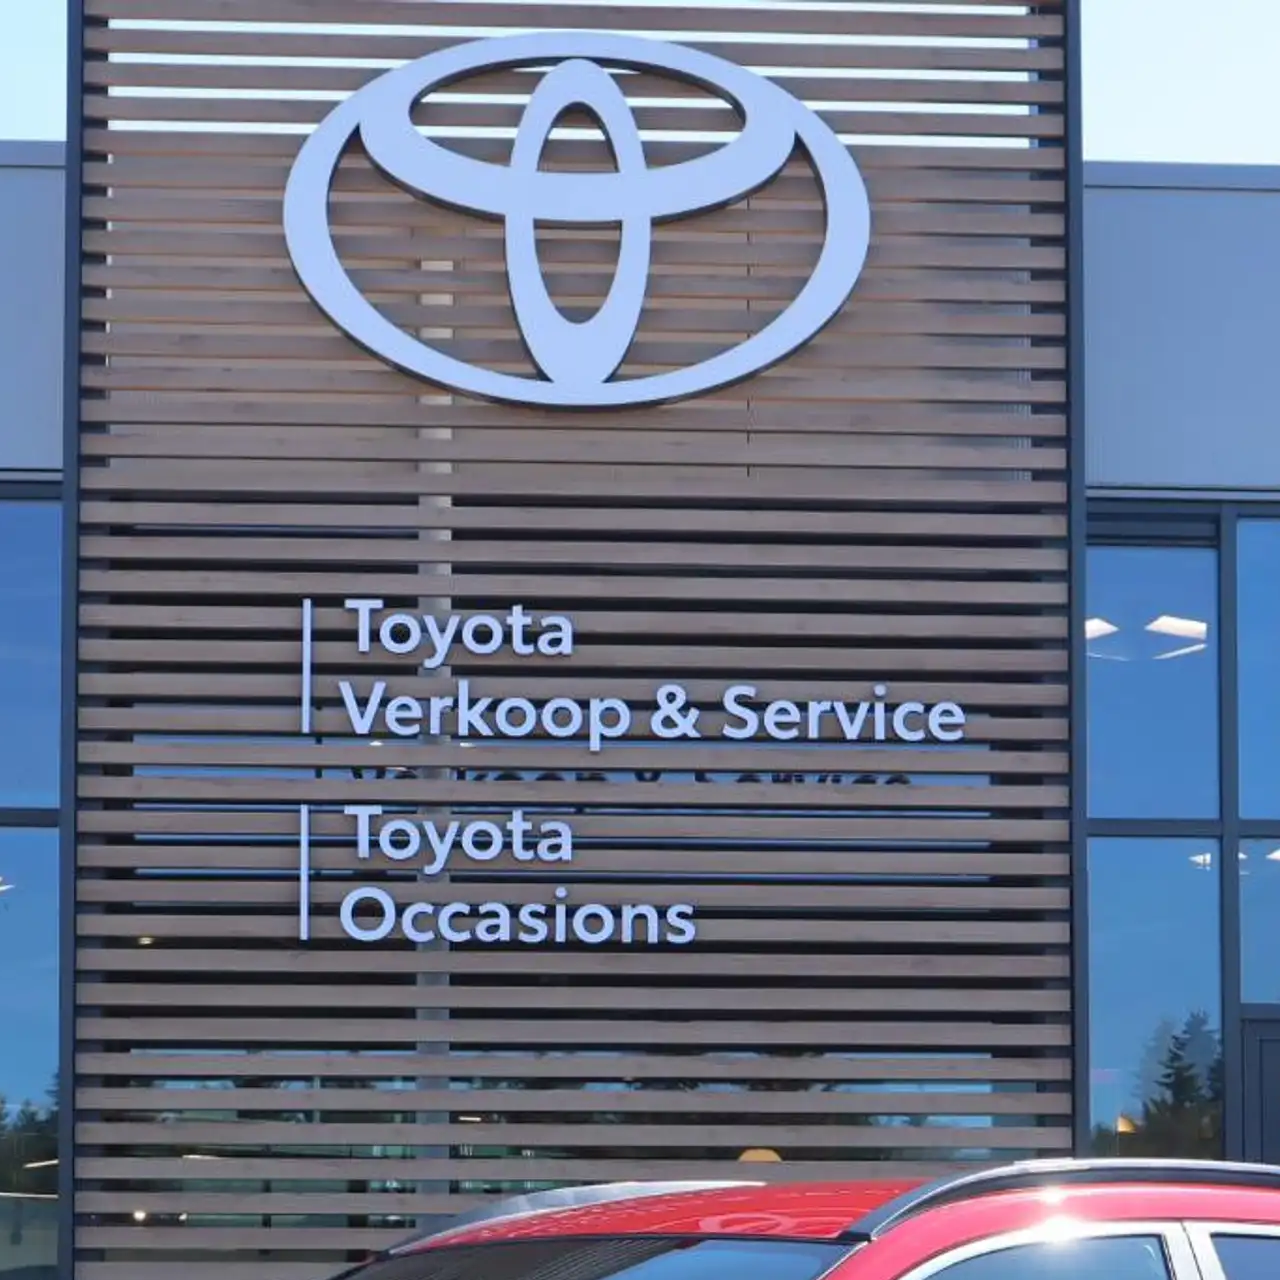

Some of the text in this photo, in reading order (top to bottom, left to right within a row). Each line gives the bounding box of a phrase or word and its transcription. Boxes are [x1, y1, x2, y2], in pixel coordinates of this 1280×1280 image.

[343, 597, 574, 670] Toyota
[338, 680, 966, 751] Verkoop & Service
[343, 805, 574, 876] Toyota
[338, 887, 696, 944] Occasions
